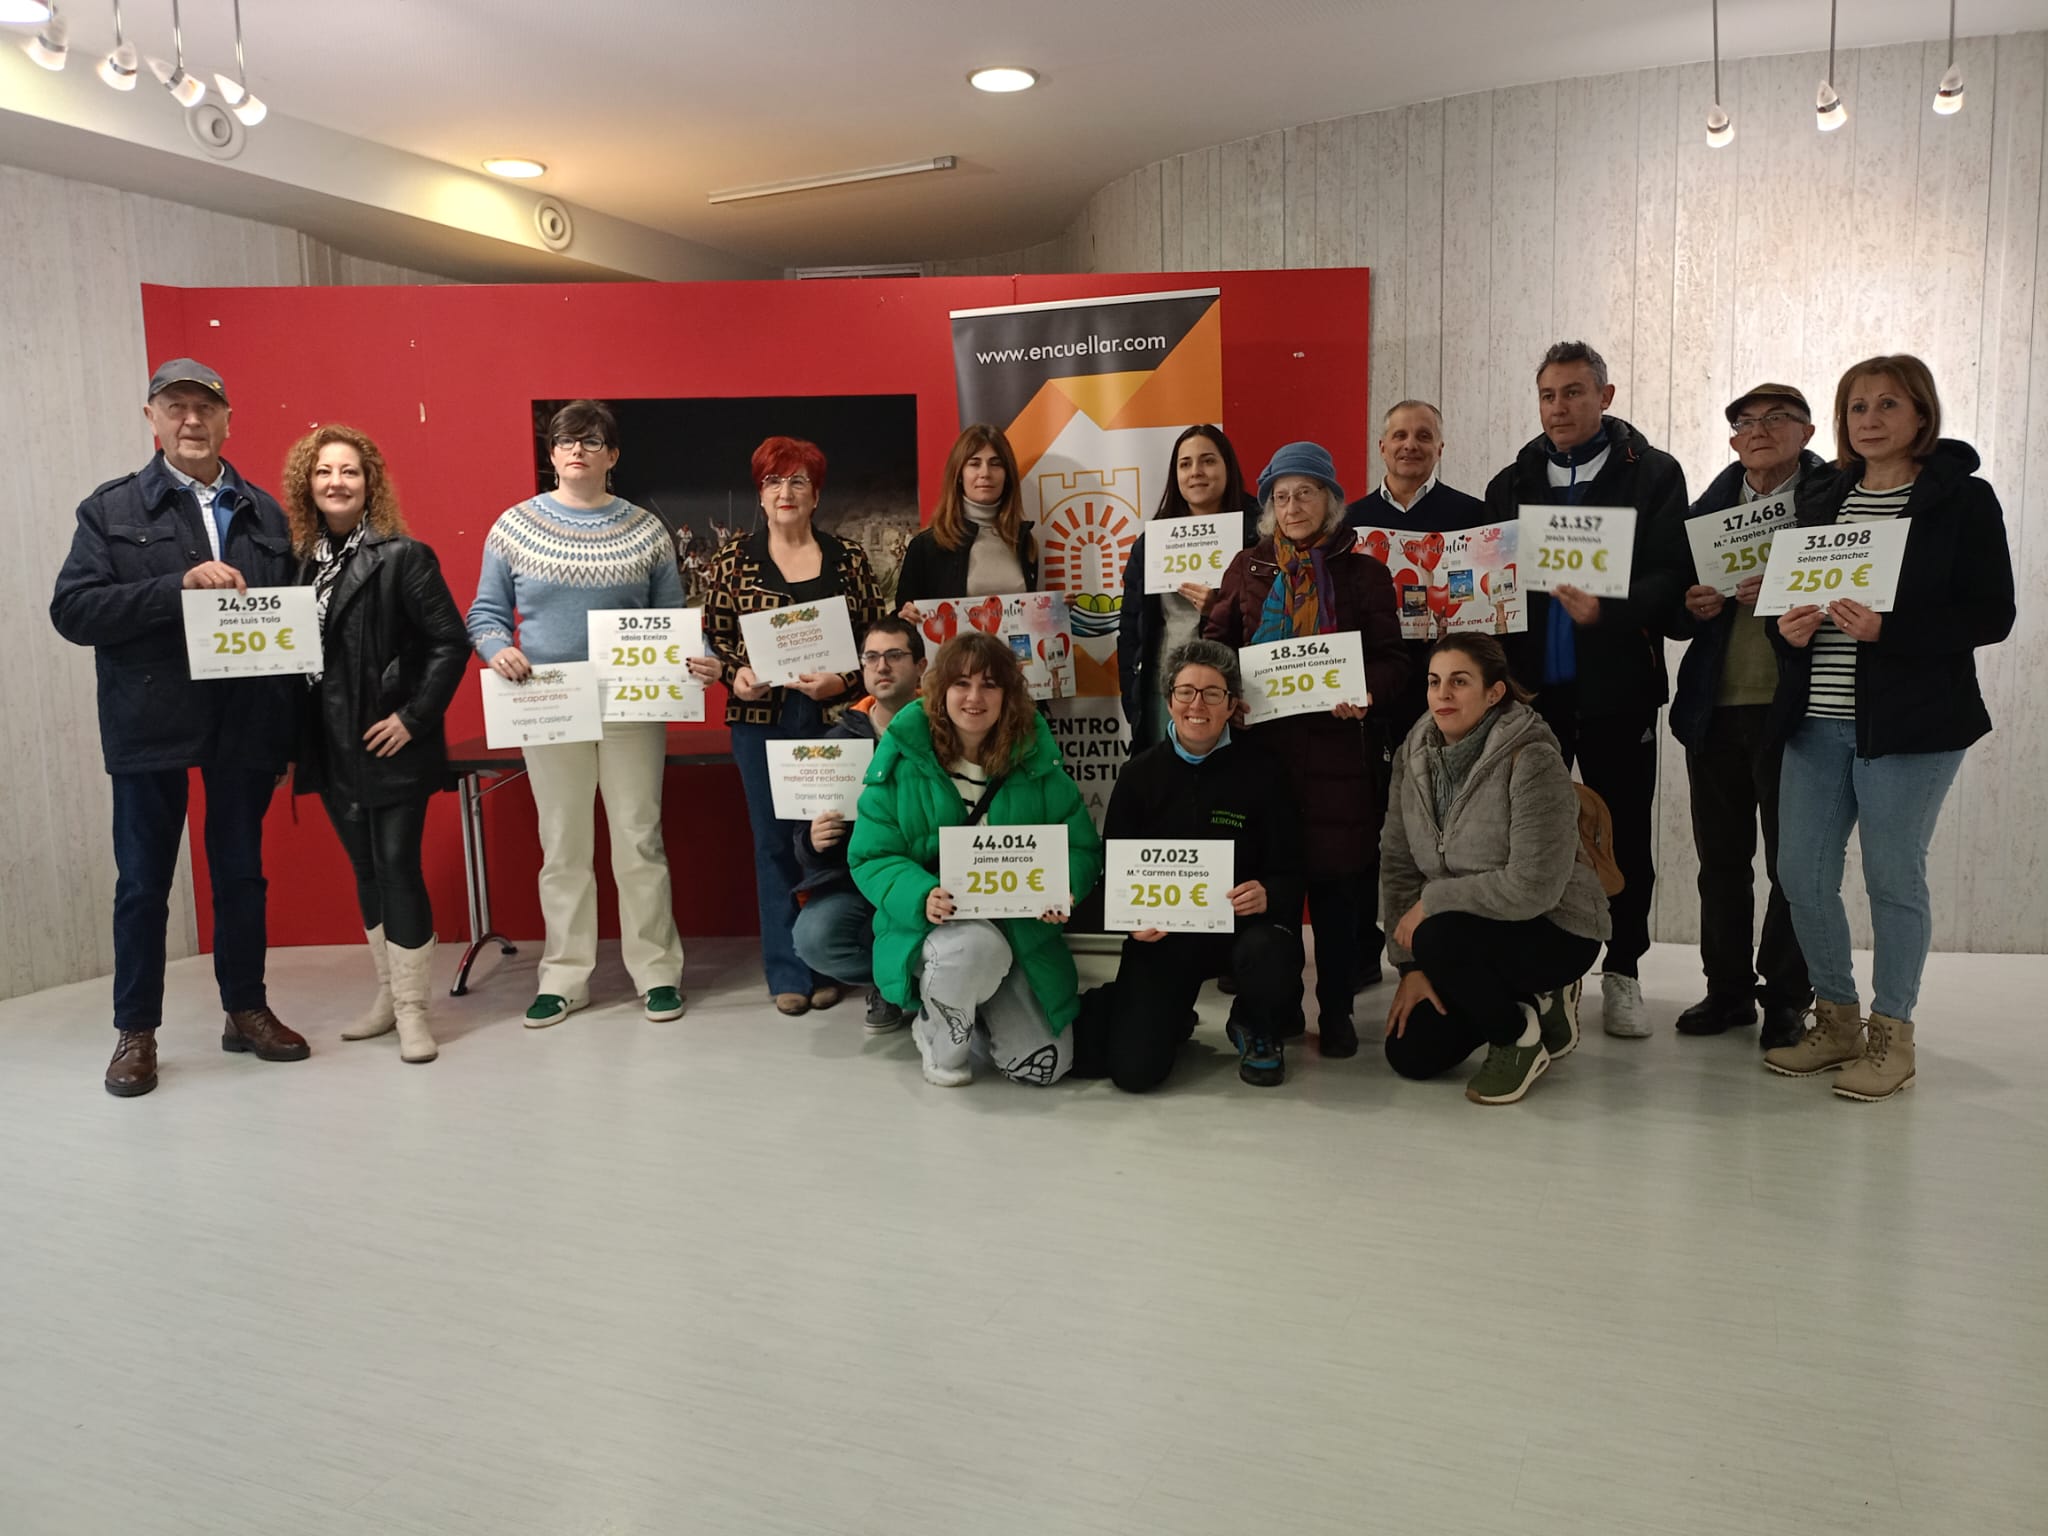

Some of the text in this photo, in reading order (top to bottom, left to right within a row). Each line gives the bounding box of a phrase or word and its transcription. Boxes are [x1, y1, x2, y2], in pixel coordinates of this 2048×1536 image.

[976, 335, 1166, 365] www.encuellar.com
[1549, 514, 1603, 532] 41.157
[1723, 502, 1786, 532] 17.468
[1170, 523, 1216, 539] 43.531
[1804, 529, 1872, 550] 31.098
[1186, 540, 1218, 549] Marinero
[1163, 549, 1223, 574] 250 €
[1537, 547, 1609, 573] 250 €
[1797, 555, 1828, 564] Selene
[1786, 563, 1873, 593] 250 €
[218, 595, 281, 612] 24.936
[219, 617, 239, 626] José
[241, 617, 258, 625] Luis
[618, 616, 671, 630] 30.755
[213, 628, 295, 654] 250 €
[776, 627, 822, 642] decoración
[777, 641, 788, 649] de
[789, 634, 823, 647] fachada
[612, 645, 681, 667] 250 €
[778, 650, 830, 666] Esther Arranz
[1270, 642, 1330, 661] 18.364
[1254, 667, 1274, 678] Juan
[1275, 662, 1307, 672] Manuel
[1308, 657, 1347, 667] González
[1265, 669, 1341, 698] 250 €
[513, 692, 569, 704] escaparates
[614, 685, 684, 701] 250 €
[512, 717, 538, 727] Viajes
[1047, 717, 1120, 735] ENTRO
[1060, 740, 1133, 757] ICIATIV
[799, 768, 818, 776] casa
[816, 774, 856, 783] reciclado
[1063, 760, 1117, 781] RÍSTI
[972, 834, 1037, 850] 44.014
[973, 855, 1034, 866] Jaime Marcos
[1140, 849, 1199, 864] 07.023
[966, 868, 1045, 895] 250 €
[1142, 869, 1176, 877] Carmen
[1178, 870, 1210, 878] Espeso
[1130, 883, 1209, 908] 250 €
